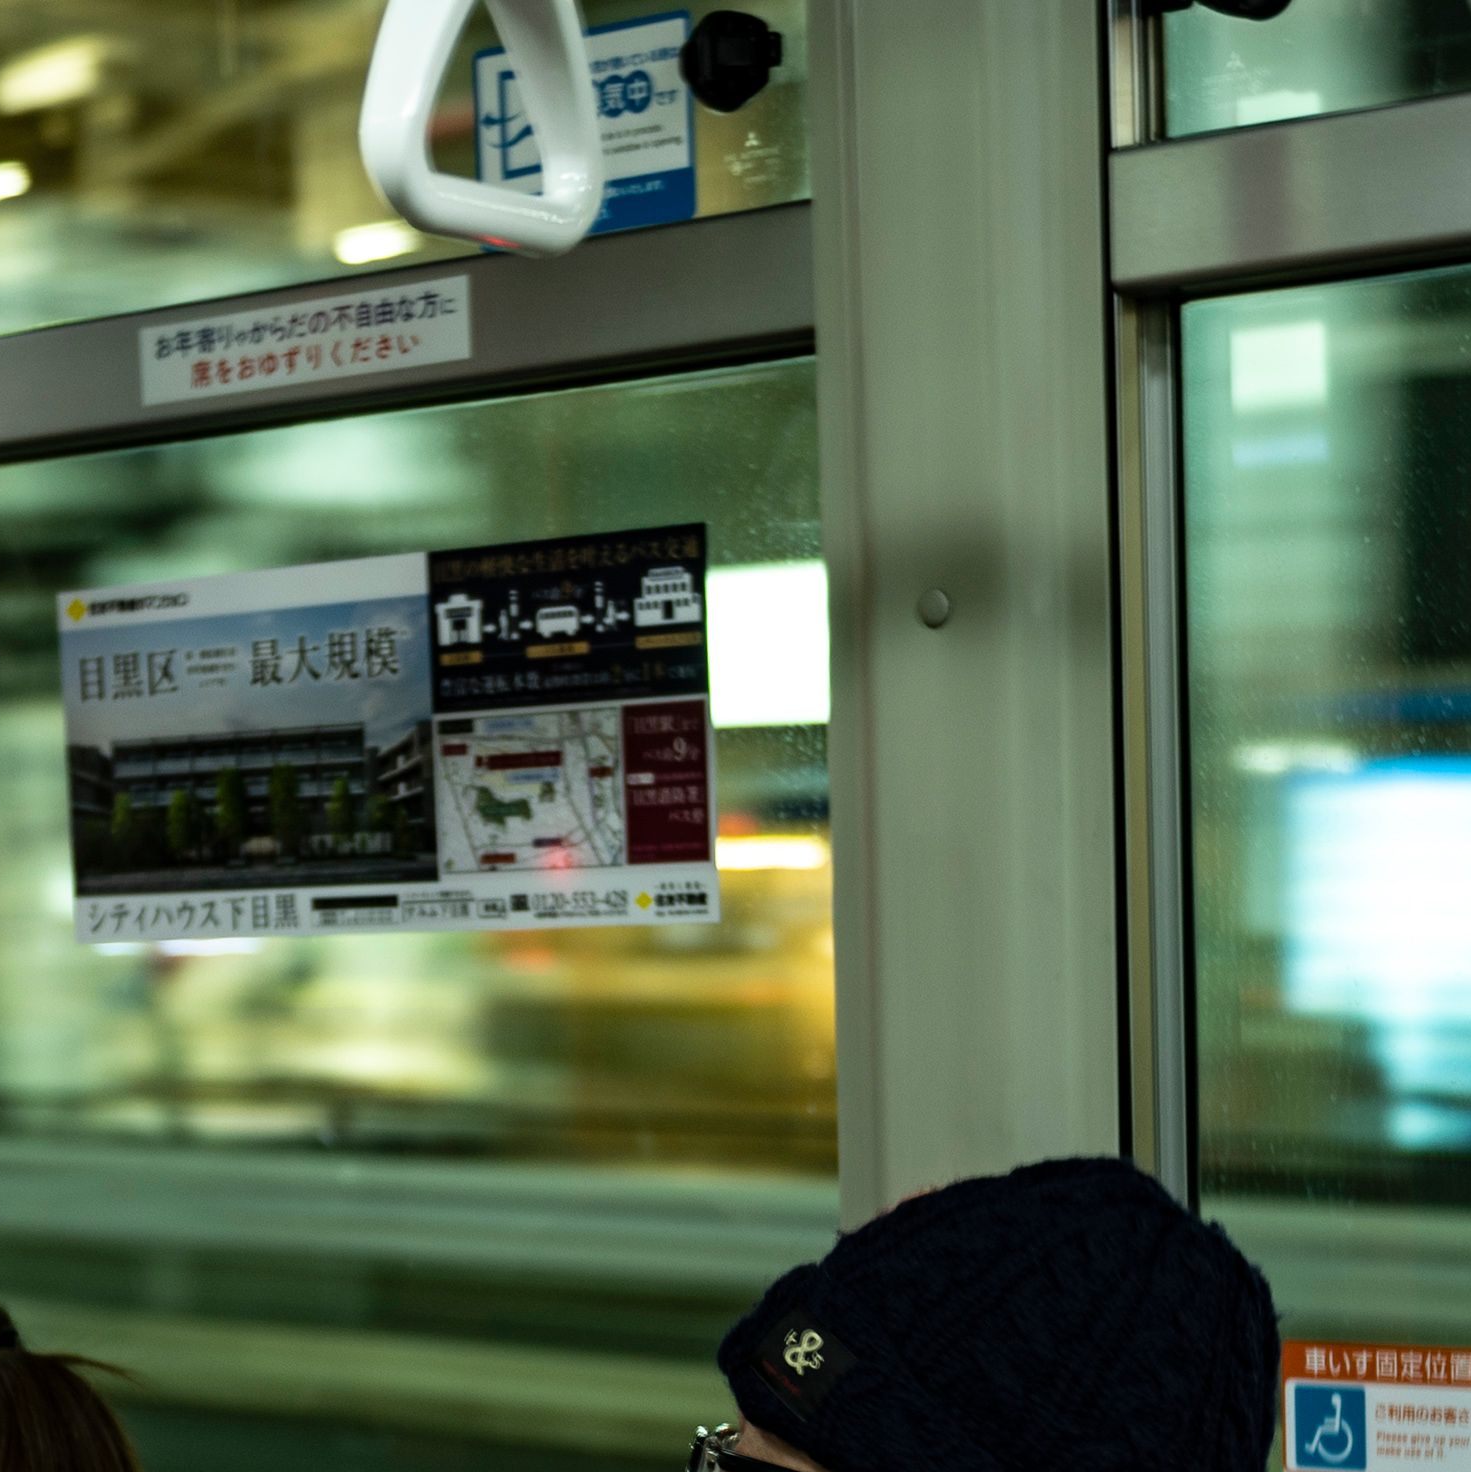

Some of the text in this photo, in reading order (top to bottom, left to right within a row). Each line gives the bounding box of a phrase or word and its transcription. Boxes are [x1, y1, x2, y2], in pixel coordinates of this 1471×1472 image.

[190, 334, 420, 389] 席をおゆずりください
[78, 648, 179, 702] 目黒区
[249, 626, 400, 687] 最大規模
[88, 893, 300, 933] シティハウス下目黒
